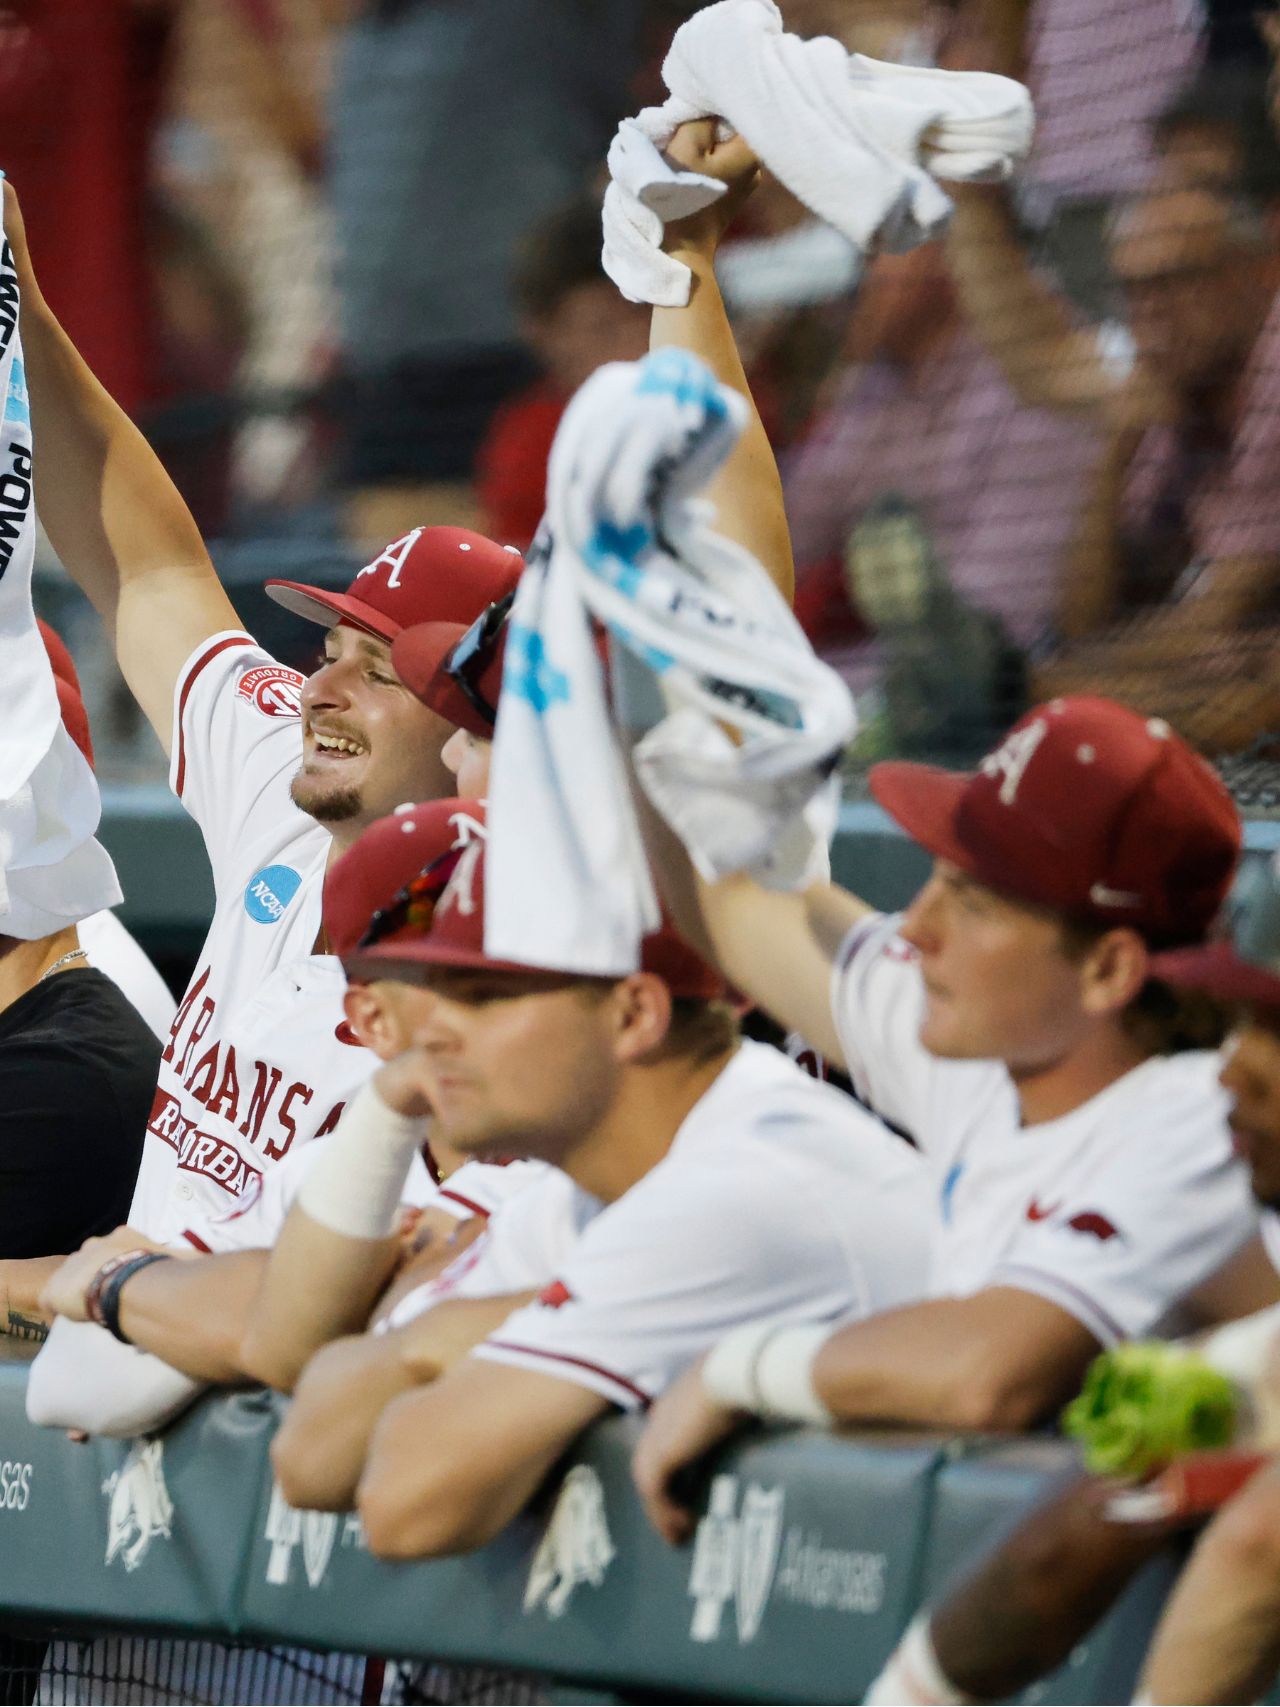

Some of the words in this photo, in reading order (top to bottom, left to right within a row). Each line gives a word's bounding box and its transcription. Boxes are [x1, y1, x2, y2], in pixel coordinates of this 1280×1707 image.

[357, 526, 426, 588] A
[243, 669, 297, 690] GRADUATE
[978, 717, 1048, 806] A
